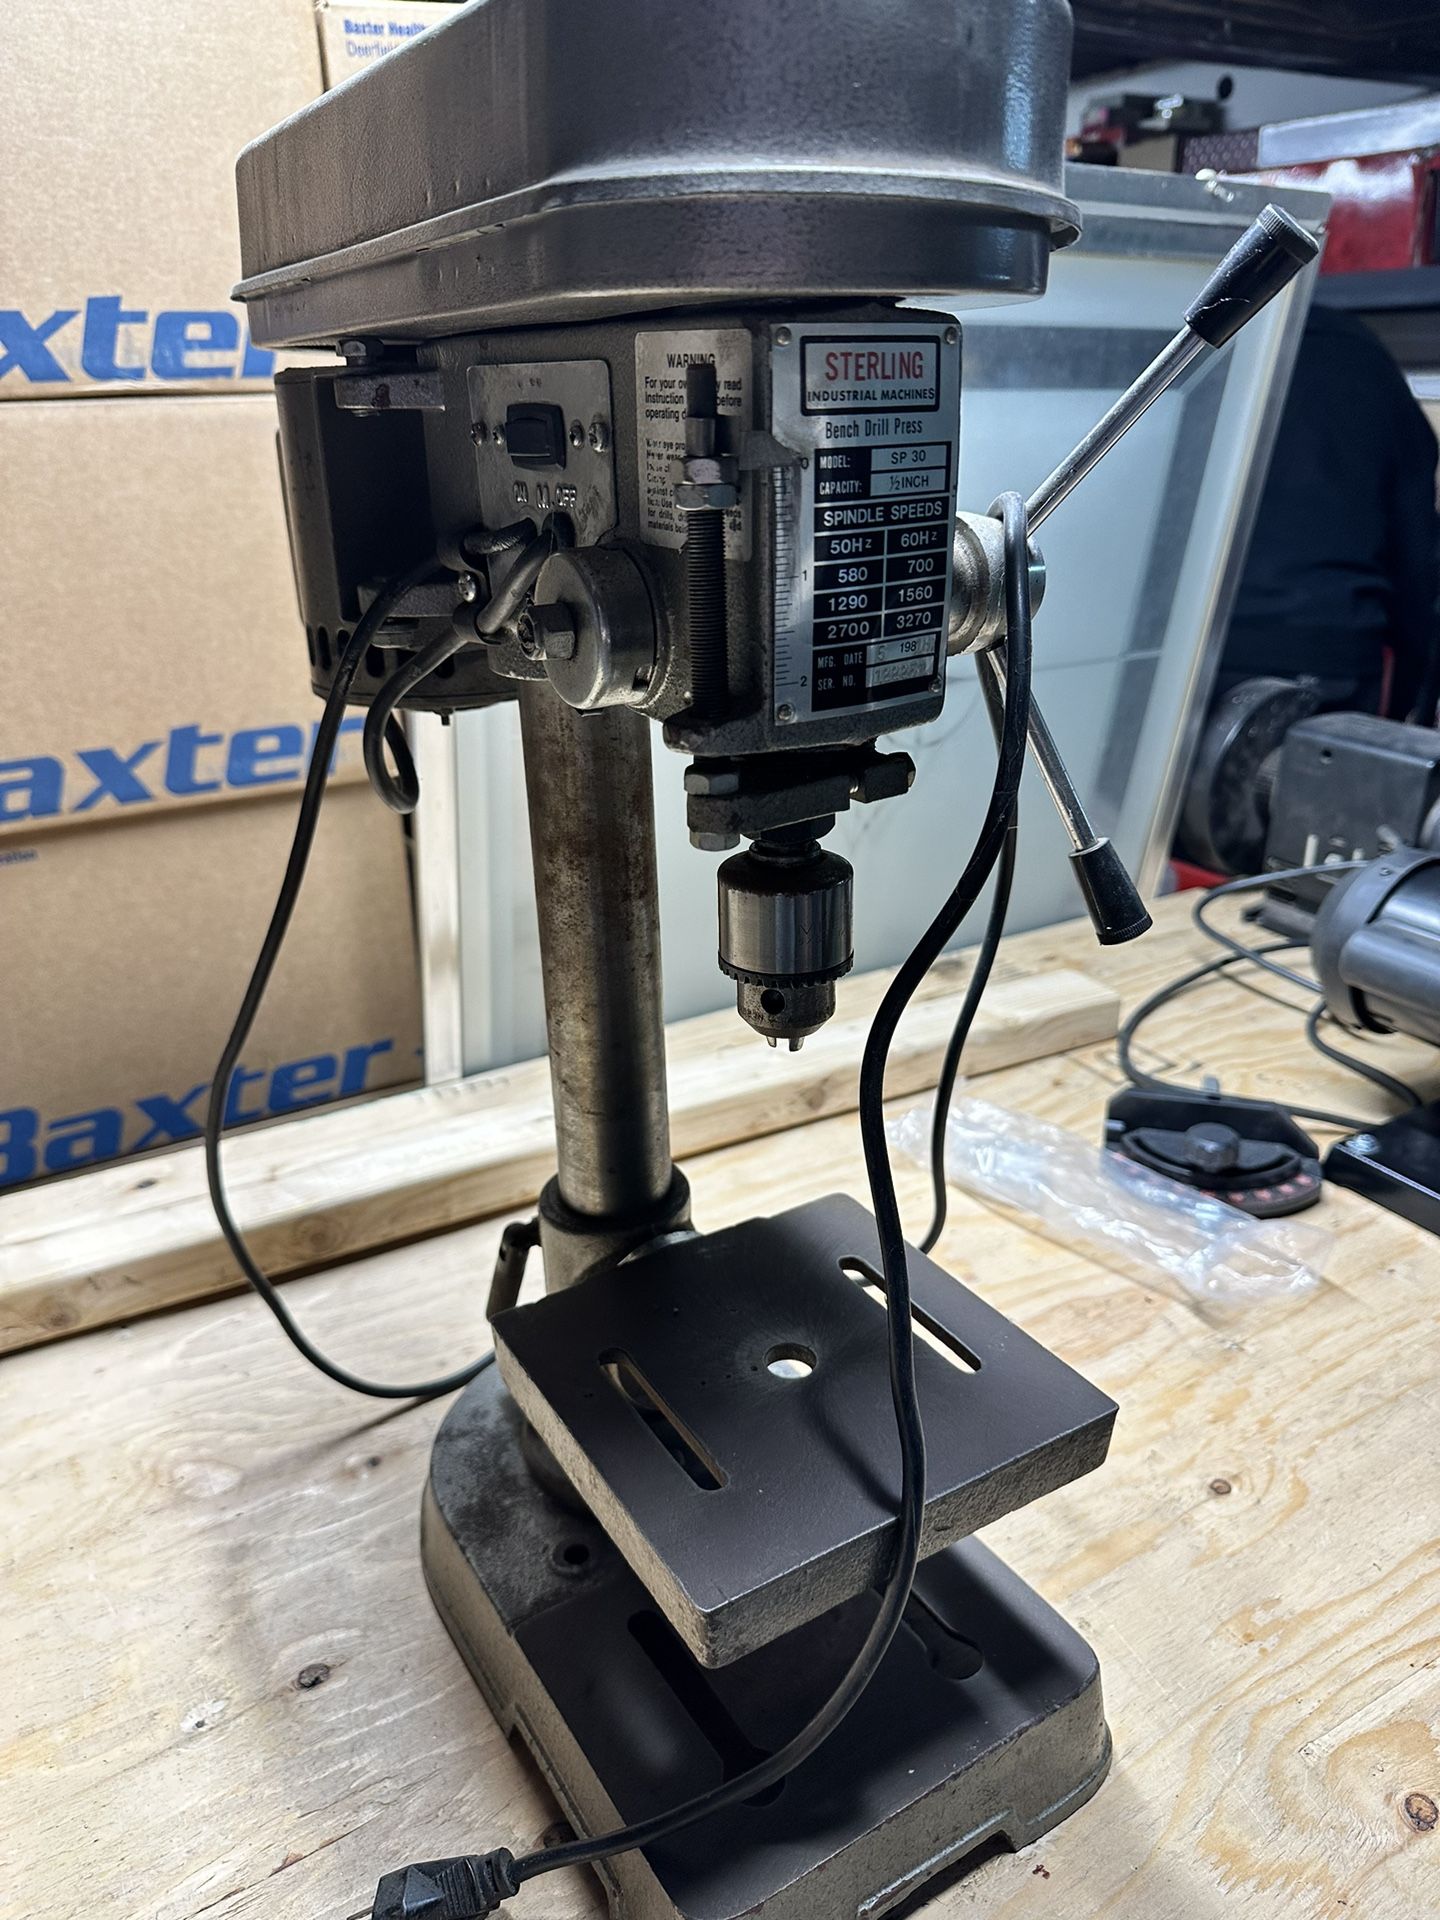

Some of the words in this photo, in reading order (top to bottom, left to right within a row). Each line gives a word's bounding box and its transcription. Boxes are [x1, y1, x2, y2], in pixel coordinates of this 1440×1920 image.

[344, 19, 384, 33] Baxter
[825, 351, 923, 381] STERLING
[645, 376, 658, 389] For
[660, 379, 676, 392] your
[645, 391, 684, 405] Instruction
[807, 389, 877, 402] INDUSTRIAL
[881, 387, 935, 400] MACHINES
[645, 407, 680, 422] operating
[825, 420, 859, 439] Bench
[865, 418, 889, 437] Drill
[894, 416, 922, 434] Press
[801, 457, 809, 470] 0
[819, 455, 851, 469] MODEL:
[891, 451, 907, 464] SP
[911, 449, 927, 463] 30
[819, 480, 862, 495] CAPACITY:
[823, 507, 884, 527] SPINDLE
[891, 501, 943, 520] SPEEDS
[802, 570, 808, 582] 1
[838, 567, 868, 583] 580
[907, 558, 934, 573] 700
[828, 594, 868, 611] 1290
[898, 585, 933, 602] 1560
[828, 621, 870, 639] 2700
[896, 611, 932, 630] 3270
[817, 656, 837, 669] MFG.
[843, 652, 863, 665] DATE
[800, 675, 808, 687] 2
[817, 677, 835, 691] SER.
[842, 673, 857, 687] NO.
